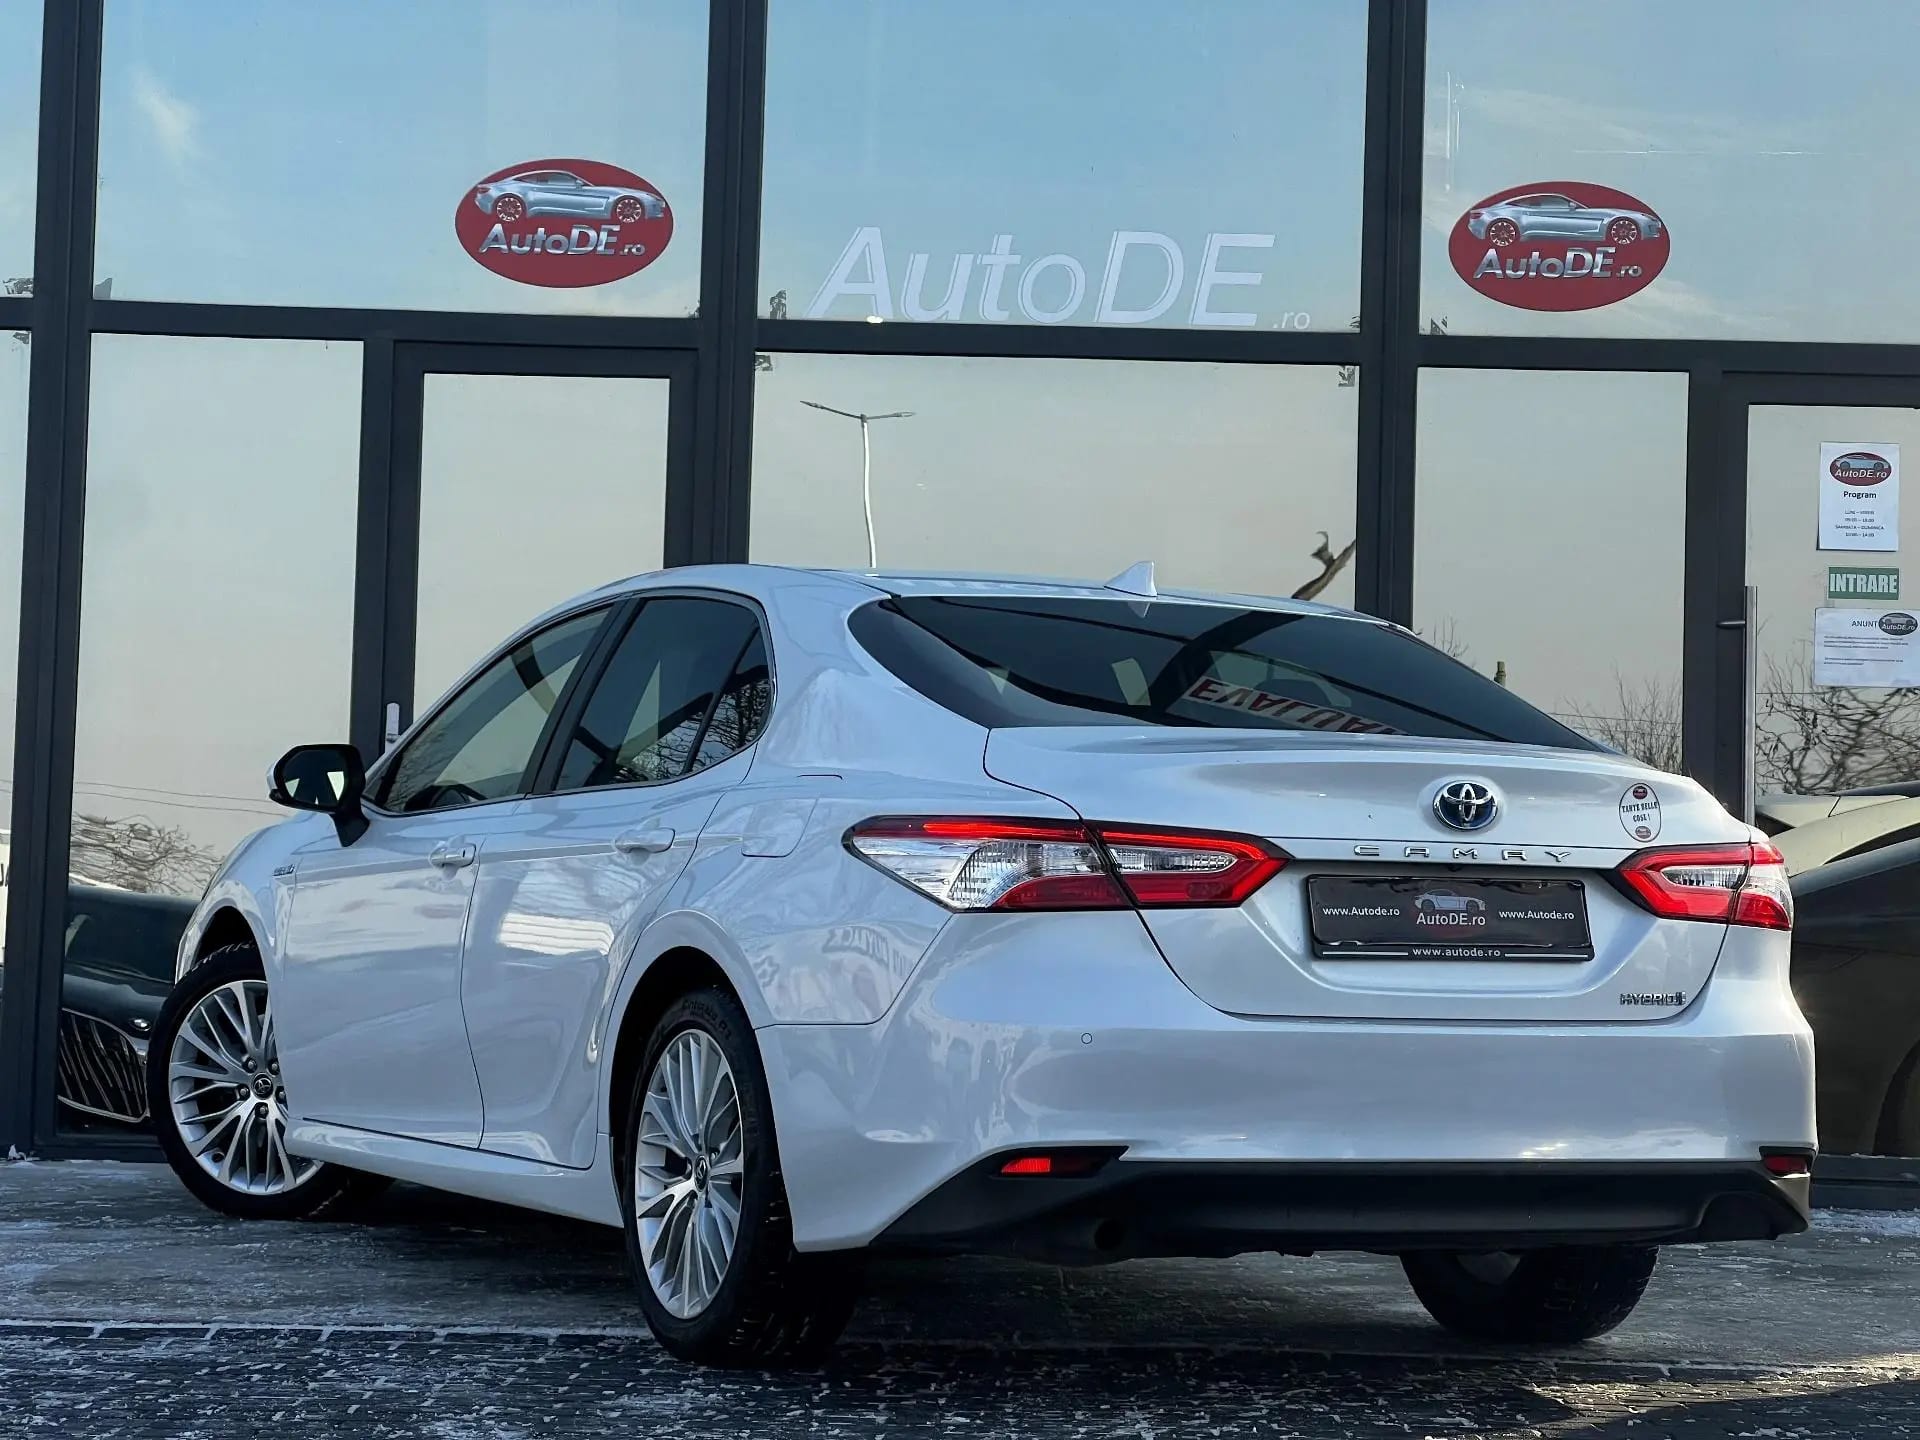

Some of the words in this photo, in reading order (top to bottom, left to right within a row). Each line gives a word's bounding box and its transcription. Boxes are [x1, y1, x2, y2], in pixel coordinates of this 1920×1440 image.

[1843, 491, 1877, 499] Program
[1829, 573, 1898, 593] INTRARE
[1353, 844, 1572, 863] CAMRY
[1322, 905, 1400, 917] www.Autode.ro
[1498, 909, 1575, 921] www.Autode.ro
[1416, 912, 1486, 926] AutoDE.ro
[1412, 947, 1501, 958] www.autode.ro
[1620, 993, 1675, 1006] HYBRID
